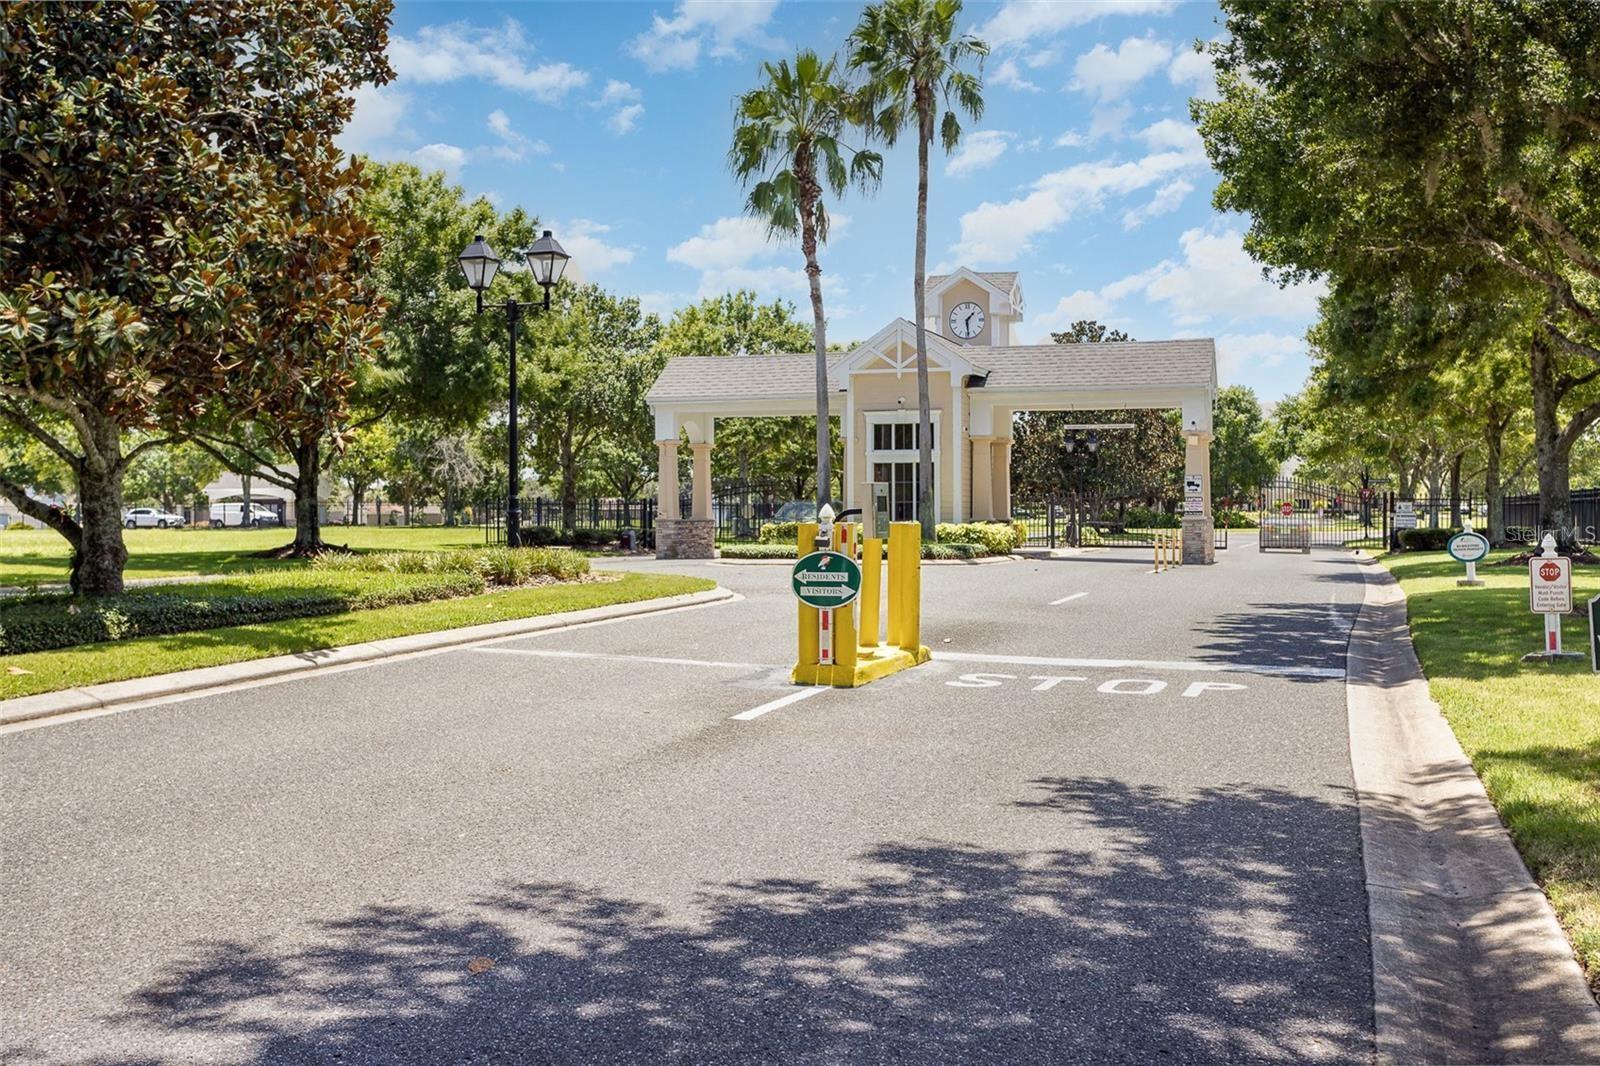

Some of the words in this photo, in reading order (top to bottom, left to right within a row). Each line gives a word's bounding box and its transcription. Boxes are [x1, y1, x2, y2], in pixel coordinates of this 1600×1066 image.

[1540, 568, 1560, 576] STOP
[802, 573, 846, 581] RESIDENTS
[945, 673, 1248, 698] STOP
